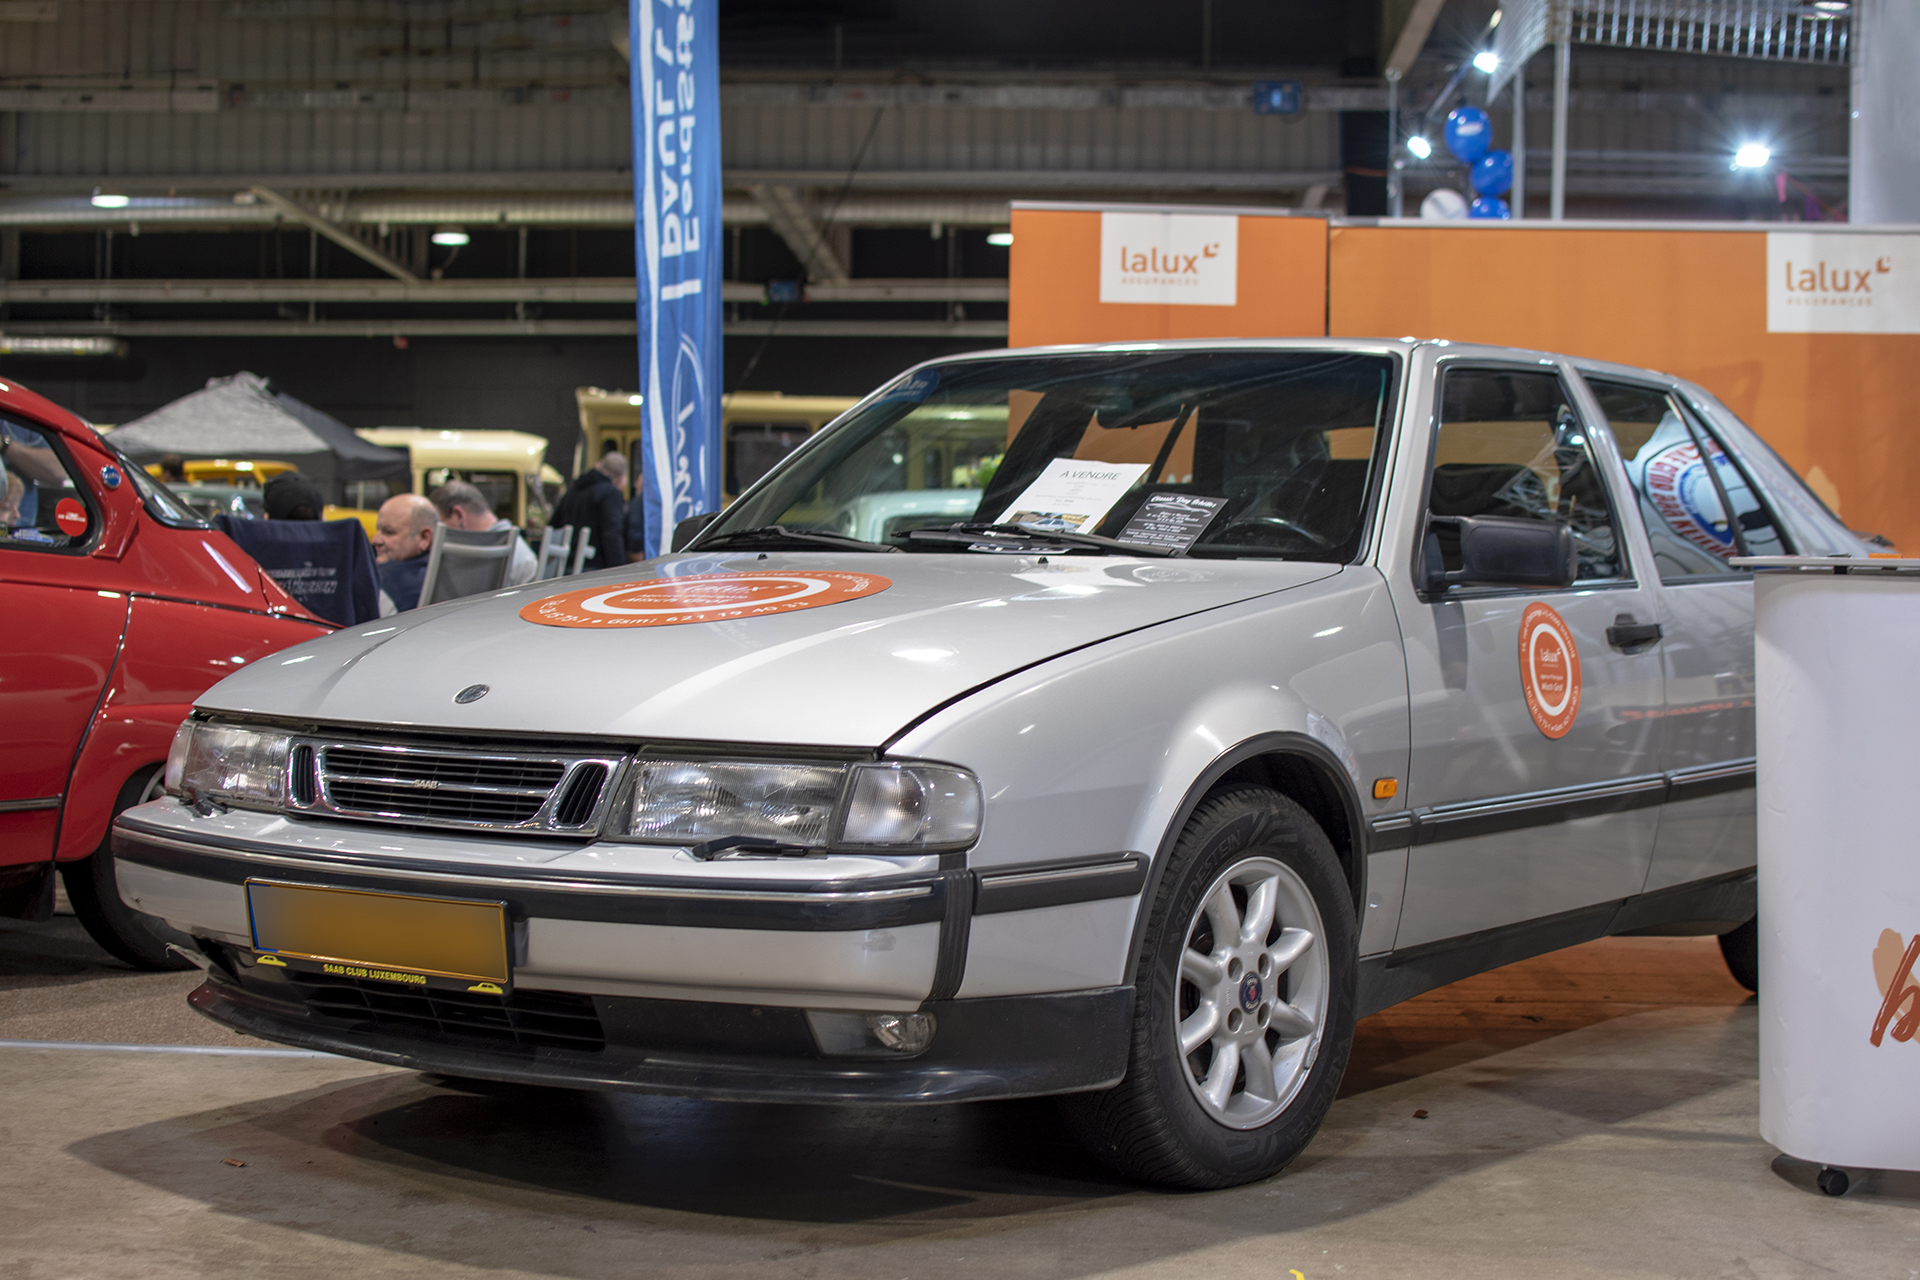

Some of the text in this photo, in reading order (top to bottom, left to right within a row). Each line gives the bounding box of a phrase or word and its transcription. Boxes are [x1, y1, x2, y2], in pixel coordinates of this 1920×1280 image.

[1120, 246, 1198, 274] lalux
[1785, 260, 1873, 293] lalux
[1073, 470, 1122, 481] VENDRE
[665, 612, 706, 623] 621
[412, 779, 439, 790] SAAB
[323, 963, 427, 986] SAAB CLUB LUXEMBOURG
